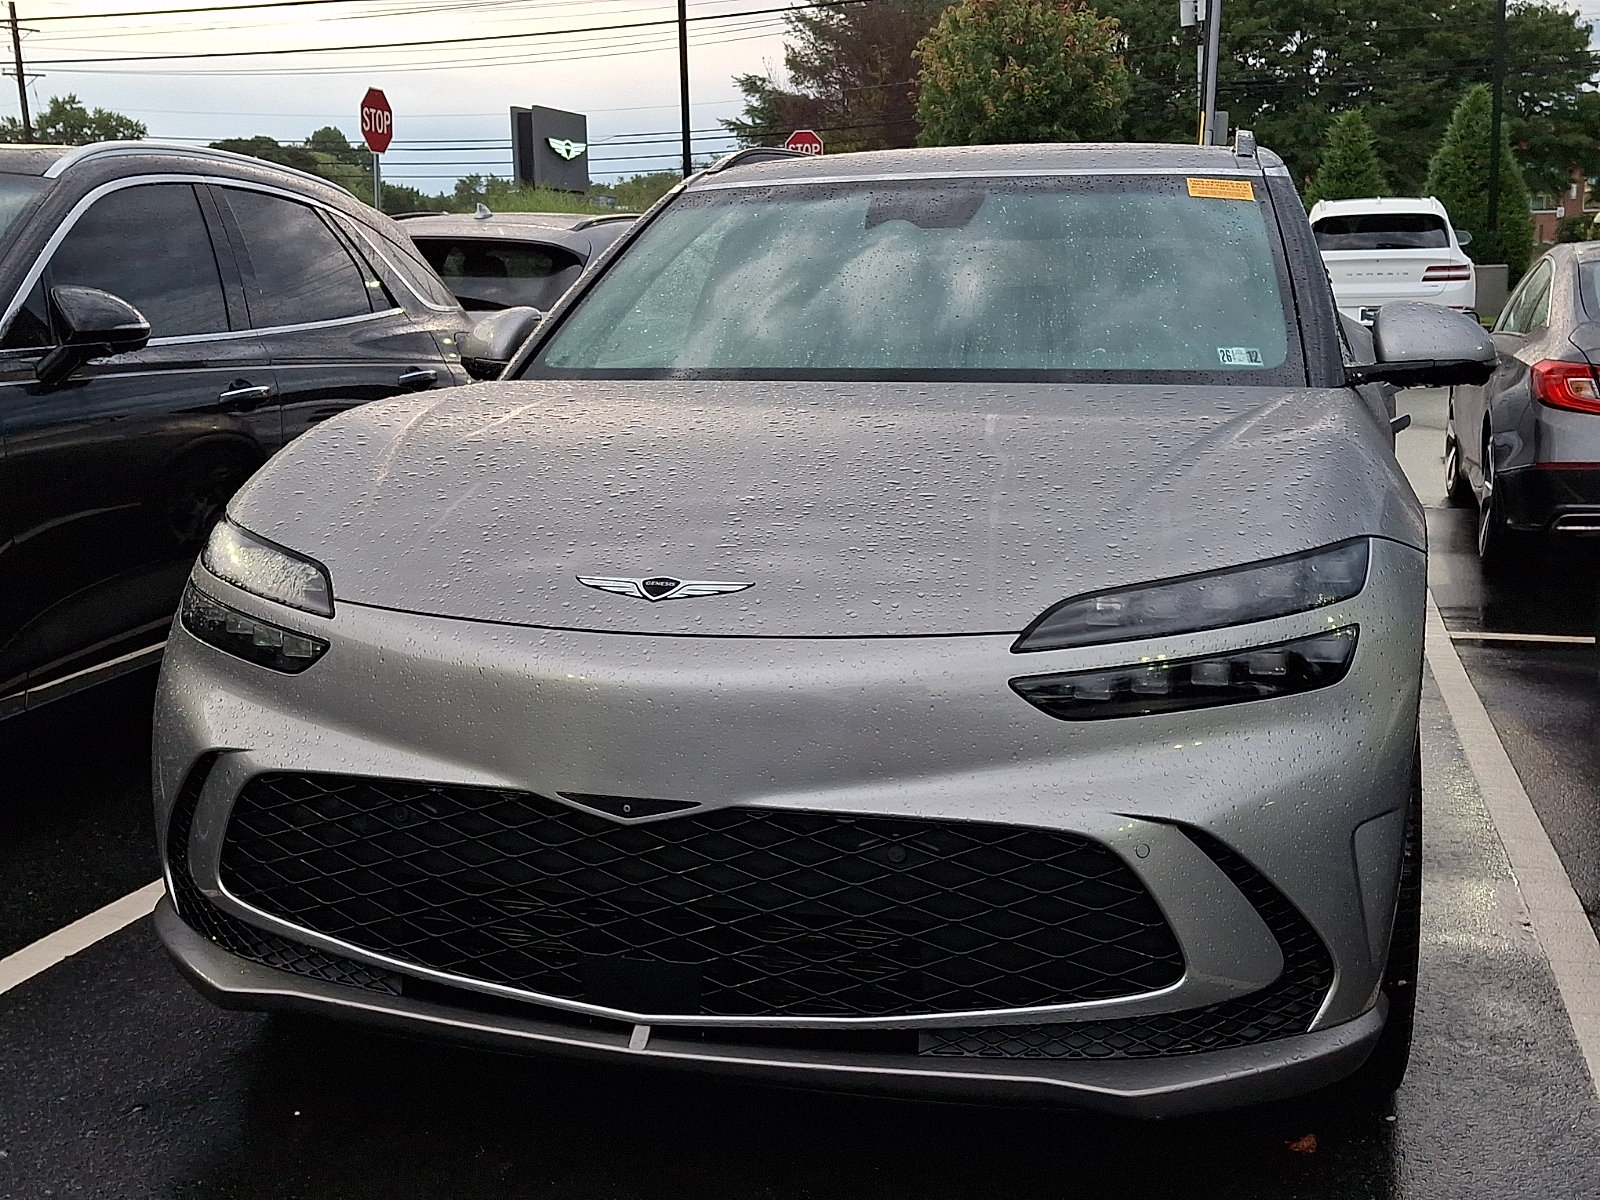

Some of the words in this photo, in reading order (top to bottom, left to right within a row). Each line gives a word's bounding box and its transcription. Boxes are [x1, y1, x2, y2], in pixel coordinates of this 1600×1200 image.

[362, 106, 391, 134] STOP
[1220, 349, 1233, 362] 26
[1246, 350, 1261, 363] 12
